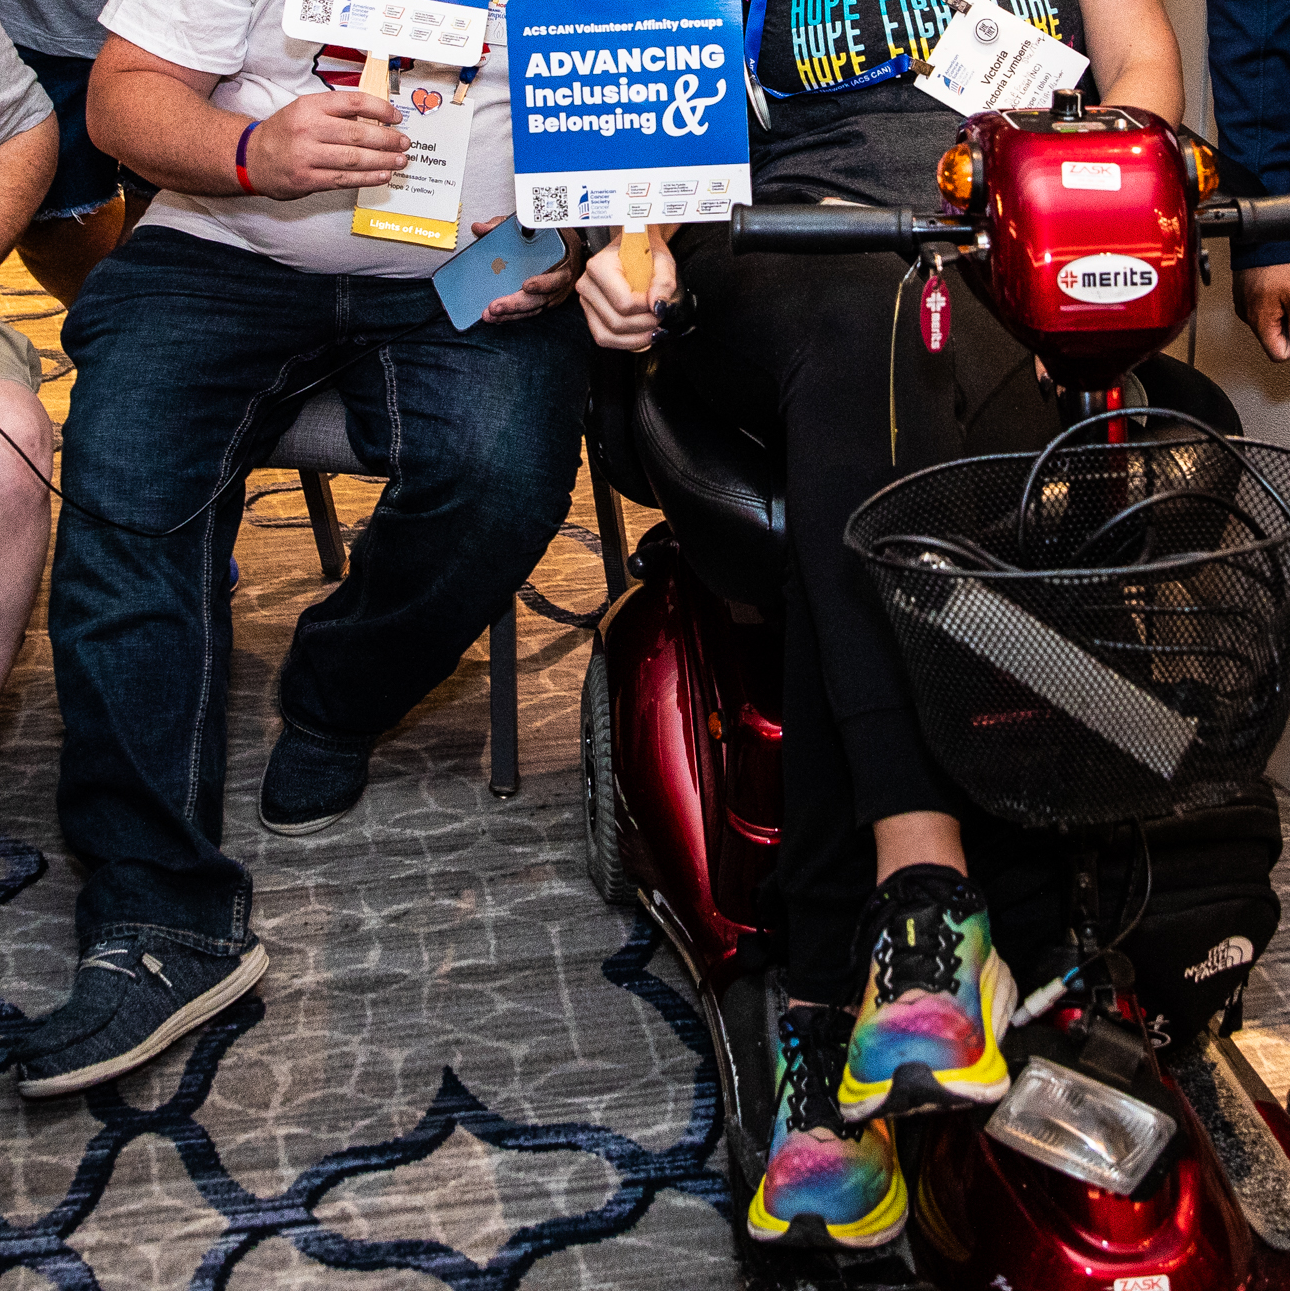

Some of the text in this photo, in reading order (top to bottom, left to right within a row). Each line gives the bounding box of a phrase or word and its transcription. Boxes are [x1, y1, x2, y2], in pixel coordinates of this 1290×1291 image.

[523, 18, 723, 36] ACS CAN Volunteer Affinity Groups
[882, 6, 953, 45] FIGH
[525, 44, 725, 78] ADVANCING
[981, 50, 1009, 85] Victoria
[850, 76, 870, 86] (ACS
[870, 66, 892, 78] CAN)
[983, 80, 1008, 110] Victoria
[1006, 39, 1033, 79] Lymberis
[1020, 79, 1033, 98] Lead
[1031, 63, 1043, 81] (NC)
[1037, 72, 1052, 92] (blue)
[525, 74, 727, 137] Inclusion &
[528, 108, 657, 137] Belonging
[410, 140, 437, 152] chael
[421, 155, 447, 166] Myers
[1069, 164, 1113, 176] ZASK
[393, 171, 427, 181] Ambassador
[388, 182, 404, 190] Hope
[411, 186, 435, 195] (yellow)
[370, 219, 401, 231] Lights
[415, 227, 441, 238] Hope
[1082, 268, 1153, 288] merits
[1120, 1278, 1163, 1291] ZASK
